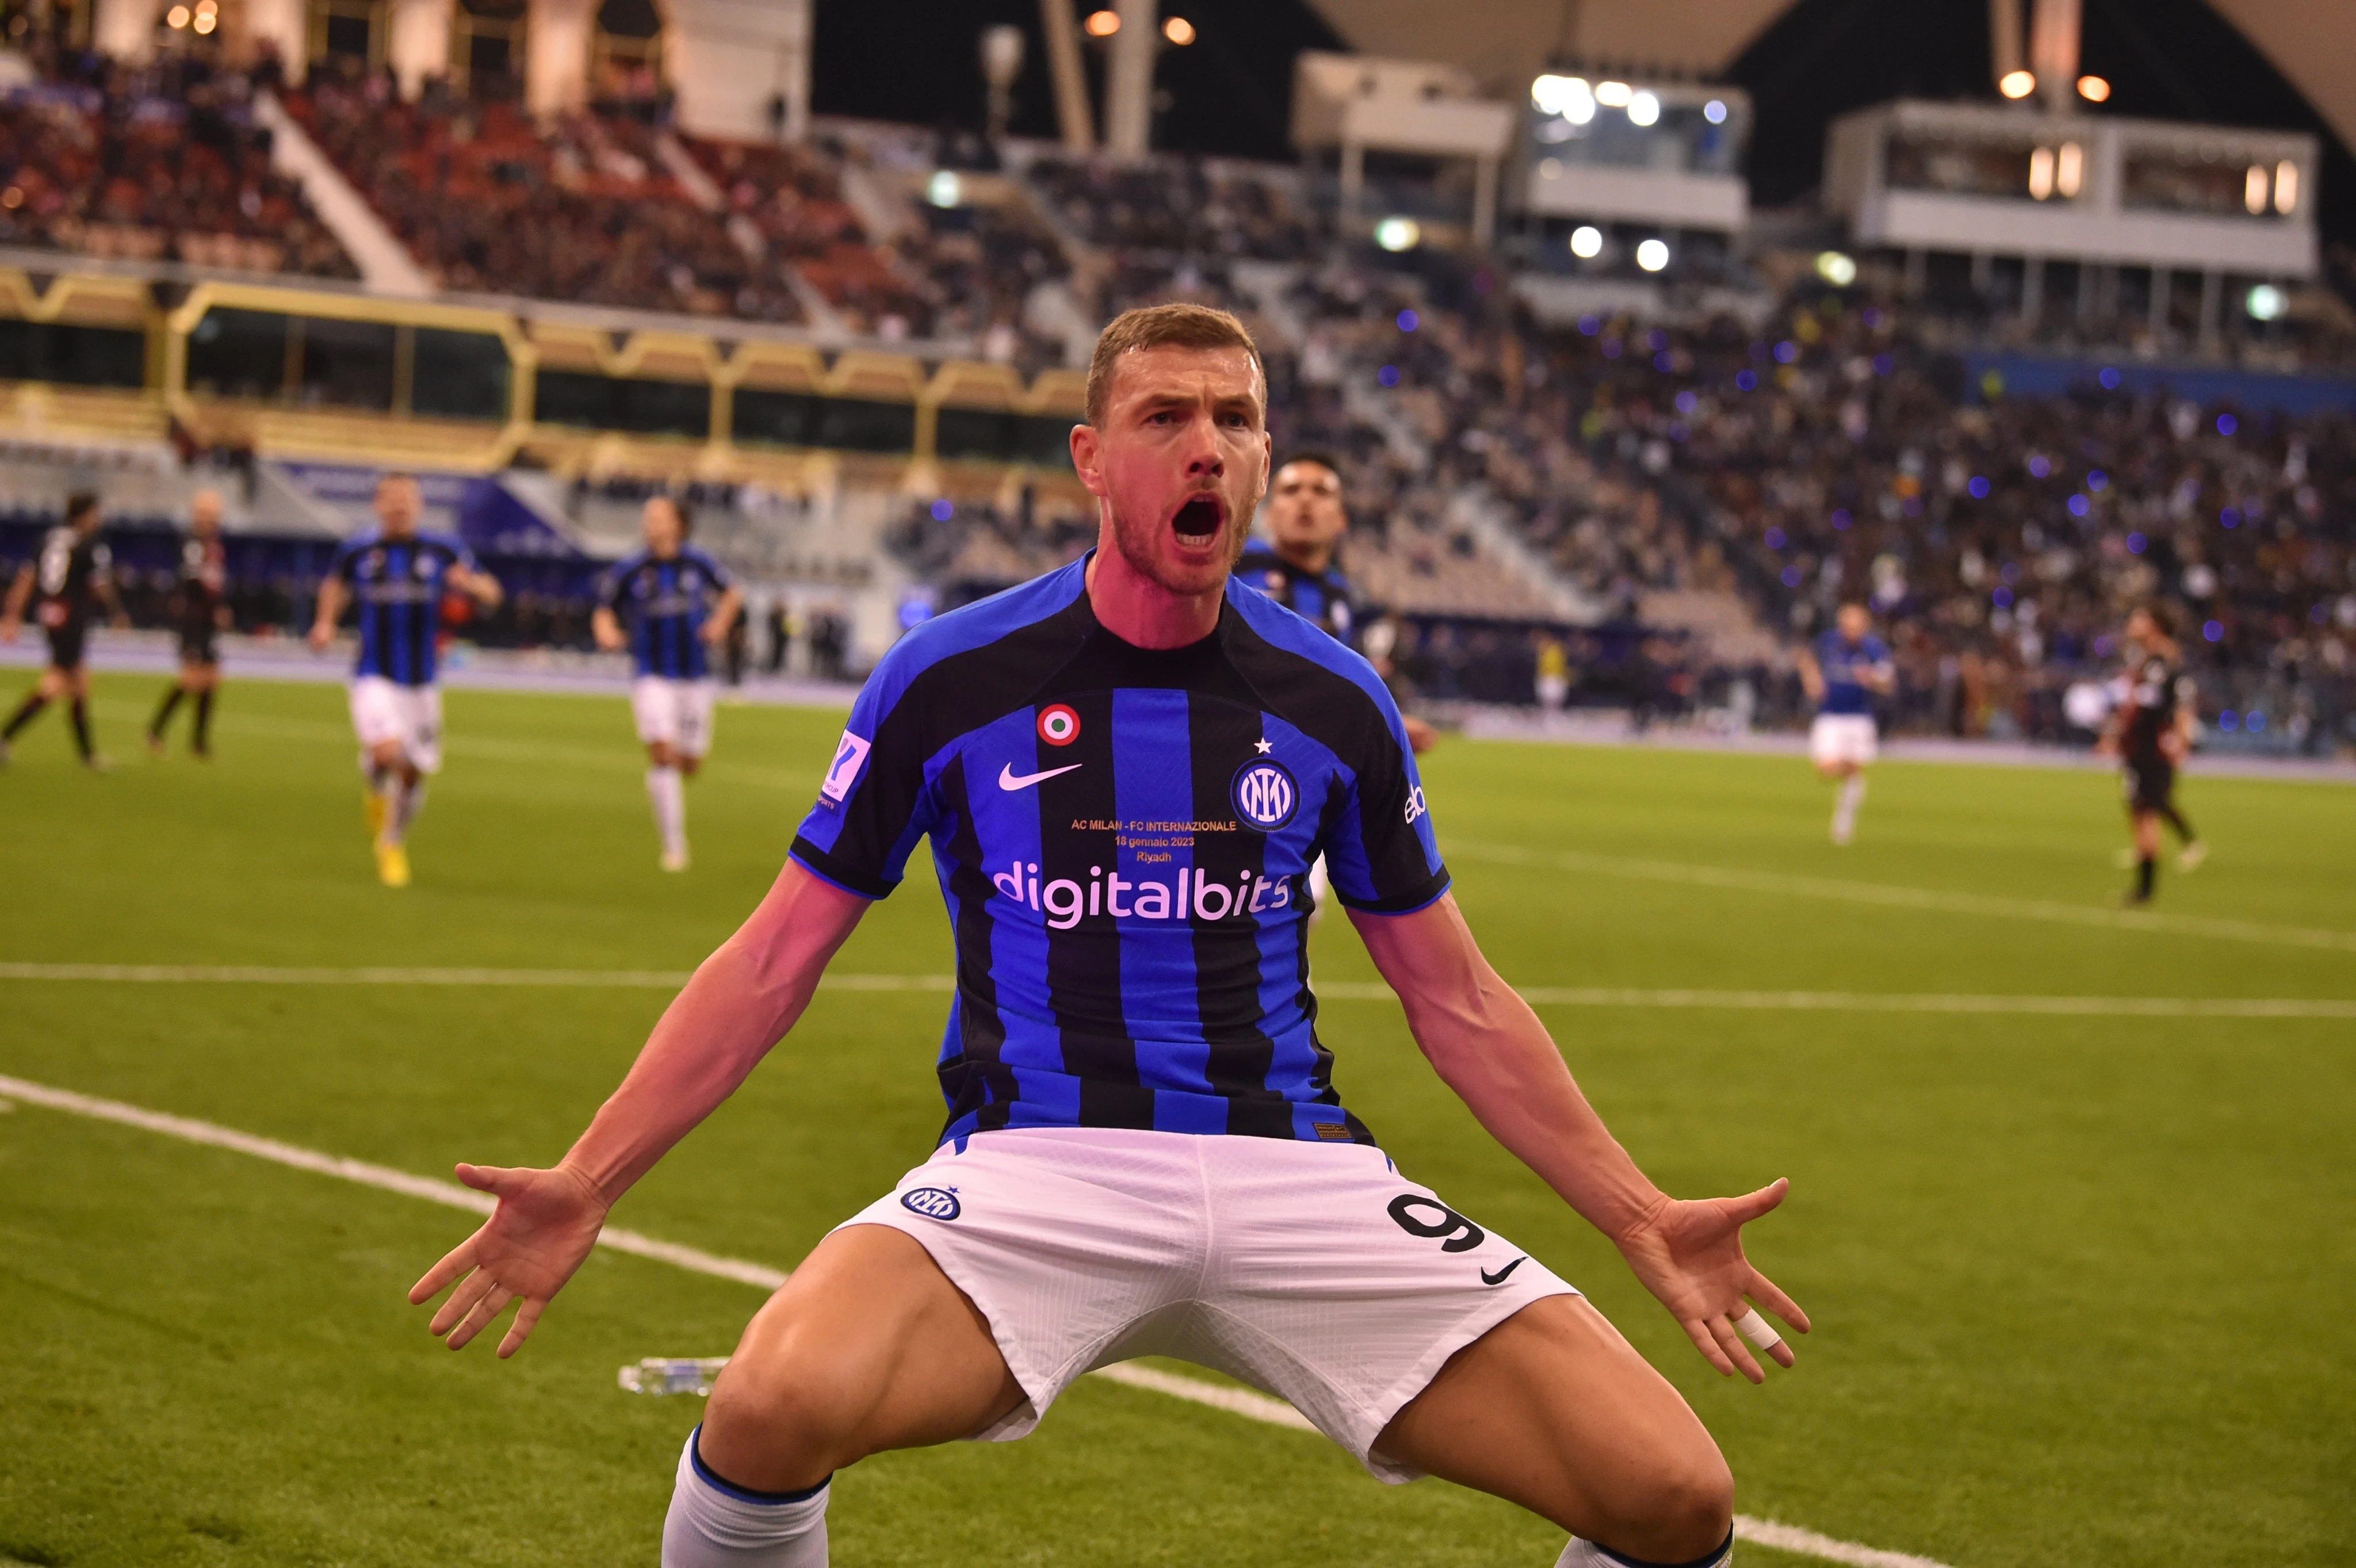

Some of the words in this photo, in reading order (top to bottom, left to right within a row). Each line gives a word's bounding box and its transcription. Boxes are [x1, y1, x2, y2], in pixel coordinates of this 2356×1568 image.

[1071, 819, 1087, 829] AC
[1089, 820, 1122, 831] MILAN
[1130, 821, 1143, 831] FC
[1146, 821, 1236, 831] INTERNAZIONALE
[1115, 836, 1126, 846] 18
[1129, 837, 1168, 848] gennaio
[1171, 837, 1195, 846] 2023
[1137, 851, 1172, 863] Riyadh
[993, 861, 1291, 930] digitalbits
[1387, 1194, 1485, 1253] 9
